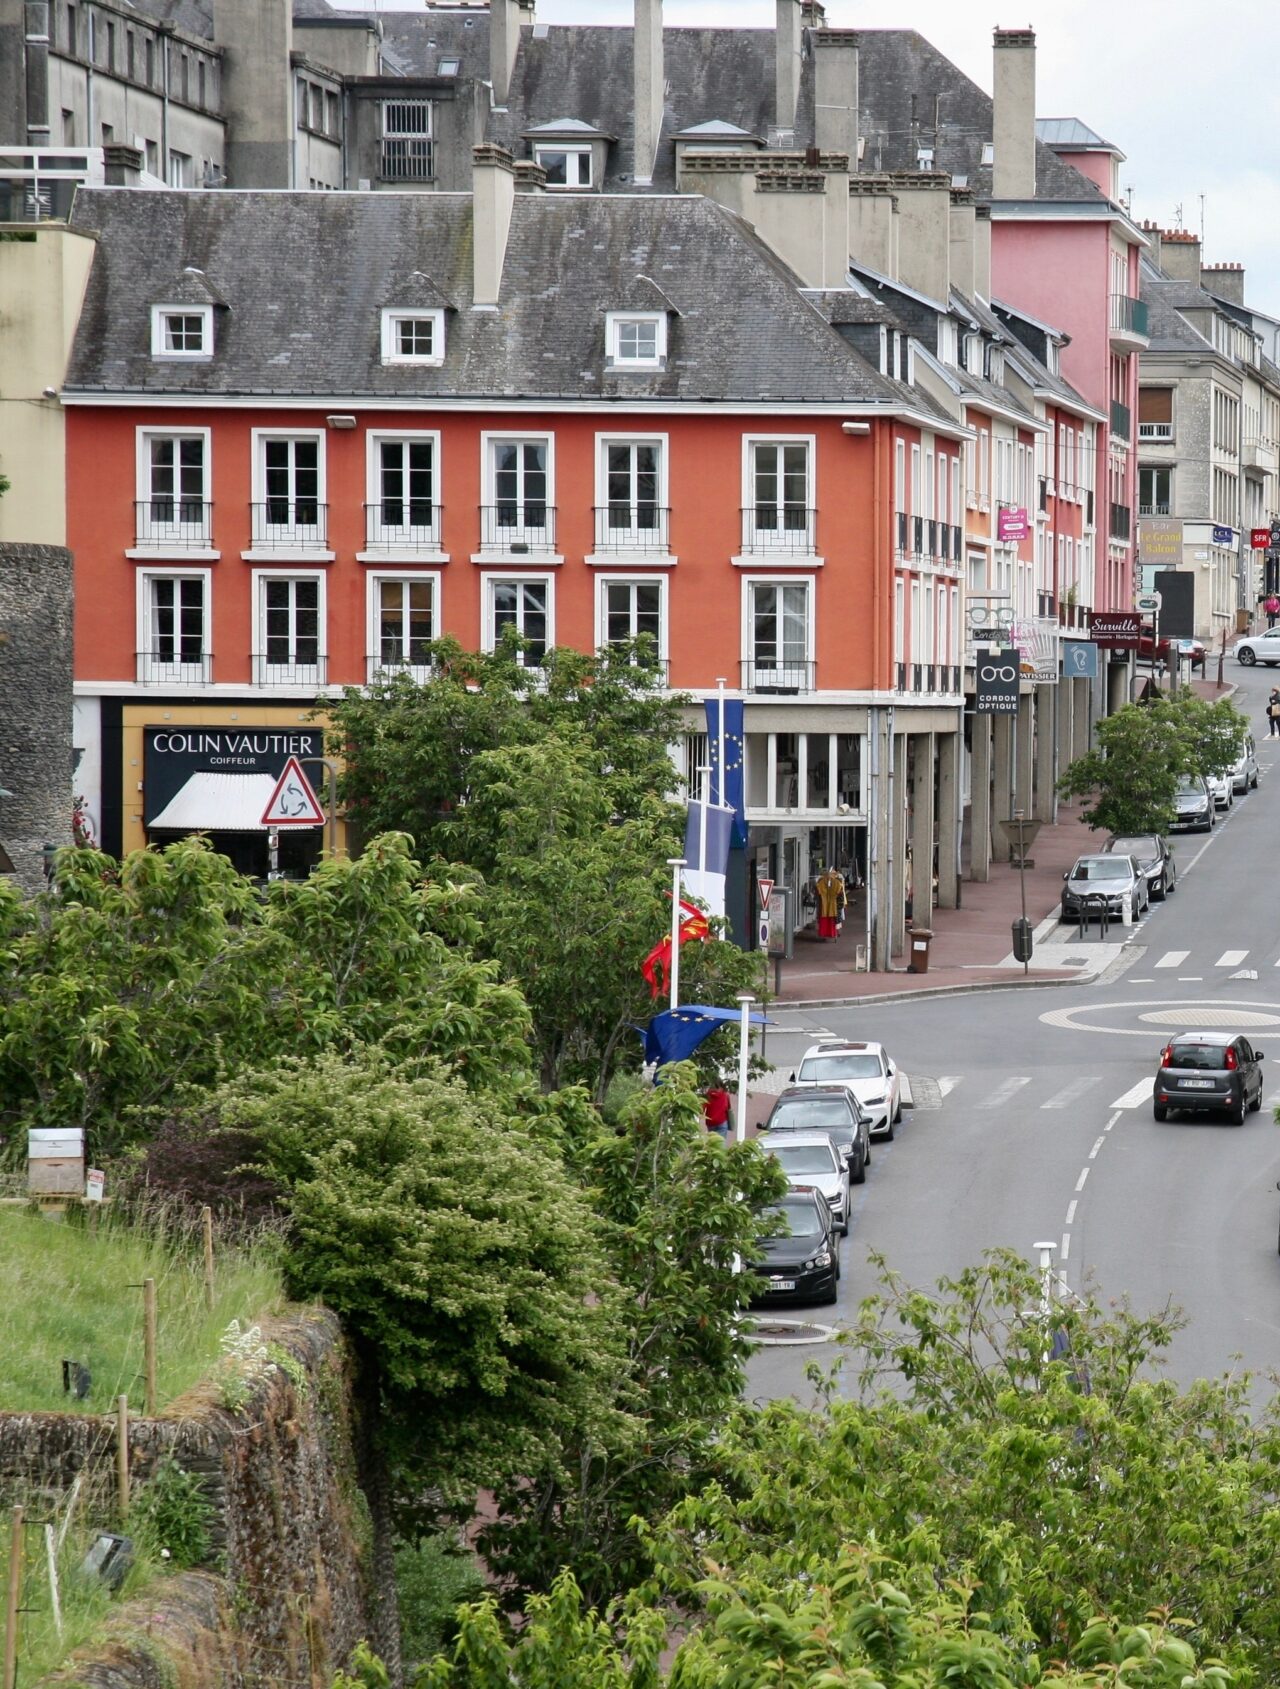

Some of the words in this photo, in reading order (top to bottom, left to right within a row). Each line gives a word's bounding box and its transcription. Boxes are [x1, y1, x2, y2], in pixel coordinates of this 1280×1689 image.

[1152, 532, 1182, 541] Grand
[1146, 543, 1176, 553] Balcon
[1091, 618, 1138, 631] Surville
[153, 734, 220, 753] COLIN
[225, 735, 313, 754] VAUTIER
[210, 757, 256, 765] COIFFEUR
